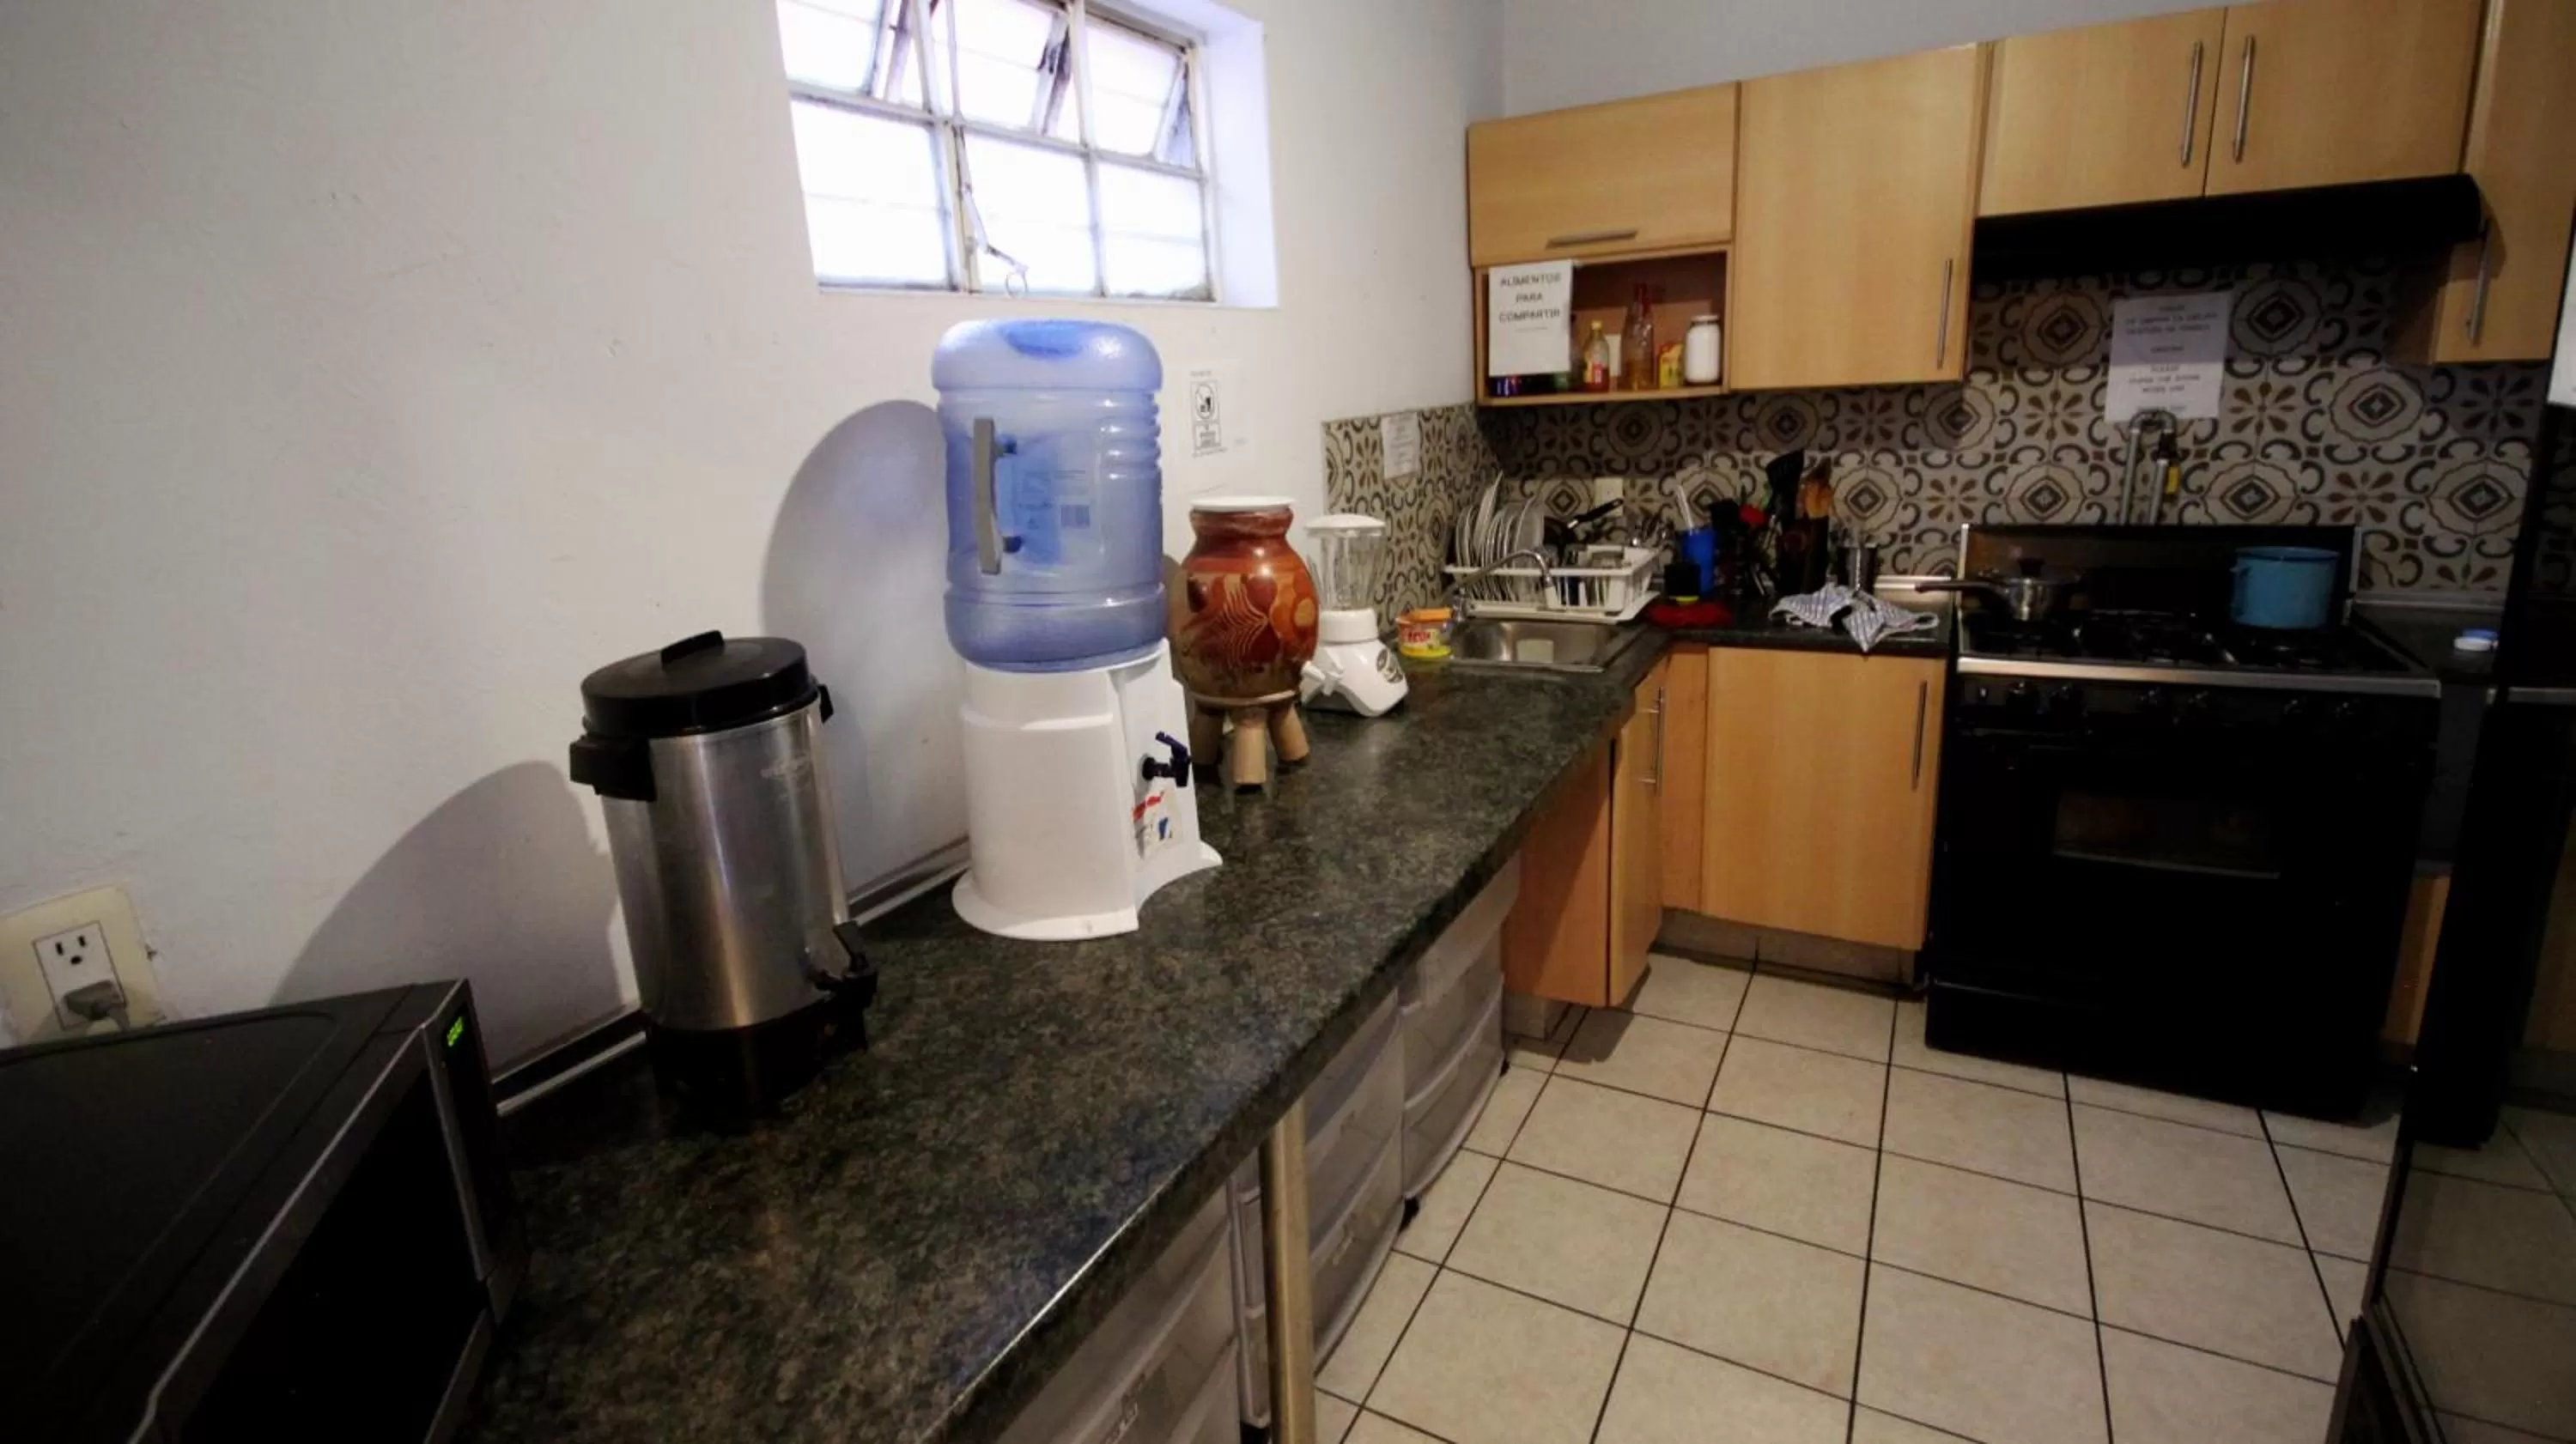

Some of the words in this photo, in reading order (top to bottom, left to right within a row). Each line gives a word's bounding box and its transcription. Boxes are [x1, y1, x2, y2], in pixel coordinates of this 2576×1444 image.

[1500, 273, 1561, 287] ALIMENTOS
[1516, 292, 1543, 303] PARA
[1499, 308, 1560, 323] COMPARTIR
